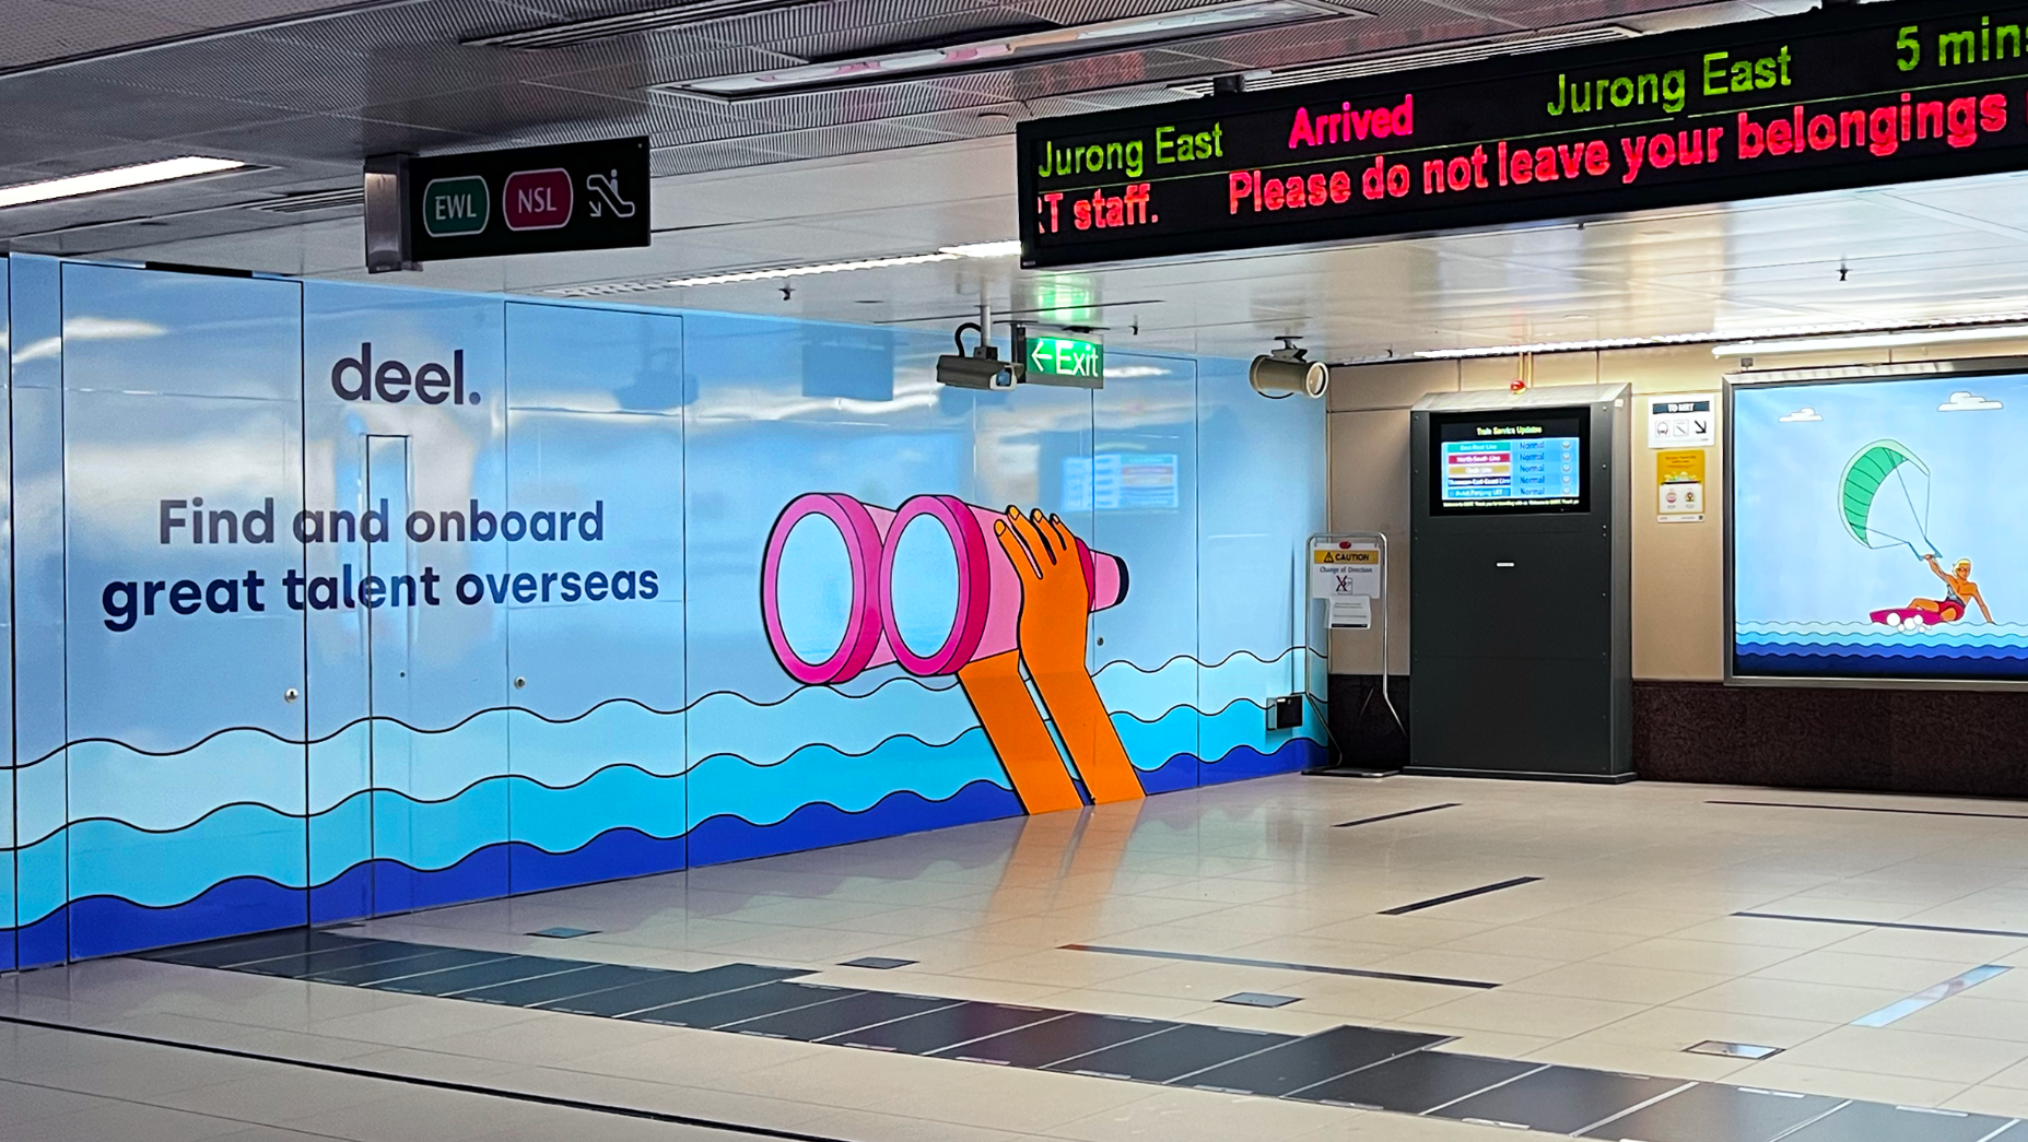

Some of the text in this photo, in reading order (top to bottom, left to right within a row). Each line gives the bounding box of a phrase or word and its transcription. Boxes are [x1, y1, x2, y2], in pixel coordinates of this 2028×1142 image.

[1896, 16, 2028, 72] 5 min
[1547, 45, 1792, 116] Jurong East
[1288, 93, 1414, 149] Arrived
[1038, 121, 1224, 178] Jurong East
[1073, 182, 1159, 231] staff.
[1228, 168, 1351, 215] Please
[1362, 154, 1410, 200] do
[1423, 143, 1489, 195] not
[1498, 140, 1611, 187] leave
[1620, 127, 1724, 185] your
[1737, 92, 2007, 160] belongings
[435, 191, 478, 222] EWL
[517, 185, 558, 215] NSL
[331, 342, 482, 405] deel.
[1055, 340, 1099, 378] Exit
[1520, 452, 1545, 460] Normal
[1520, 464, 1545, 472] Normal
[1520, 475, 1545, 484] Normal
[1520, 487, 1545, 495] Normal
[159, 497, 604, 544] Find and onboard
[1335, 553, 1369, 561] CAUTION
[102, 563, 660, 632] great talent overseas
